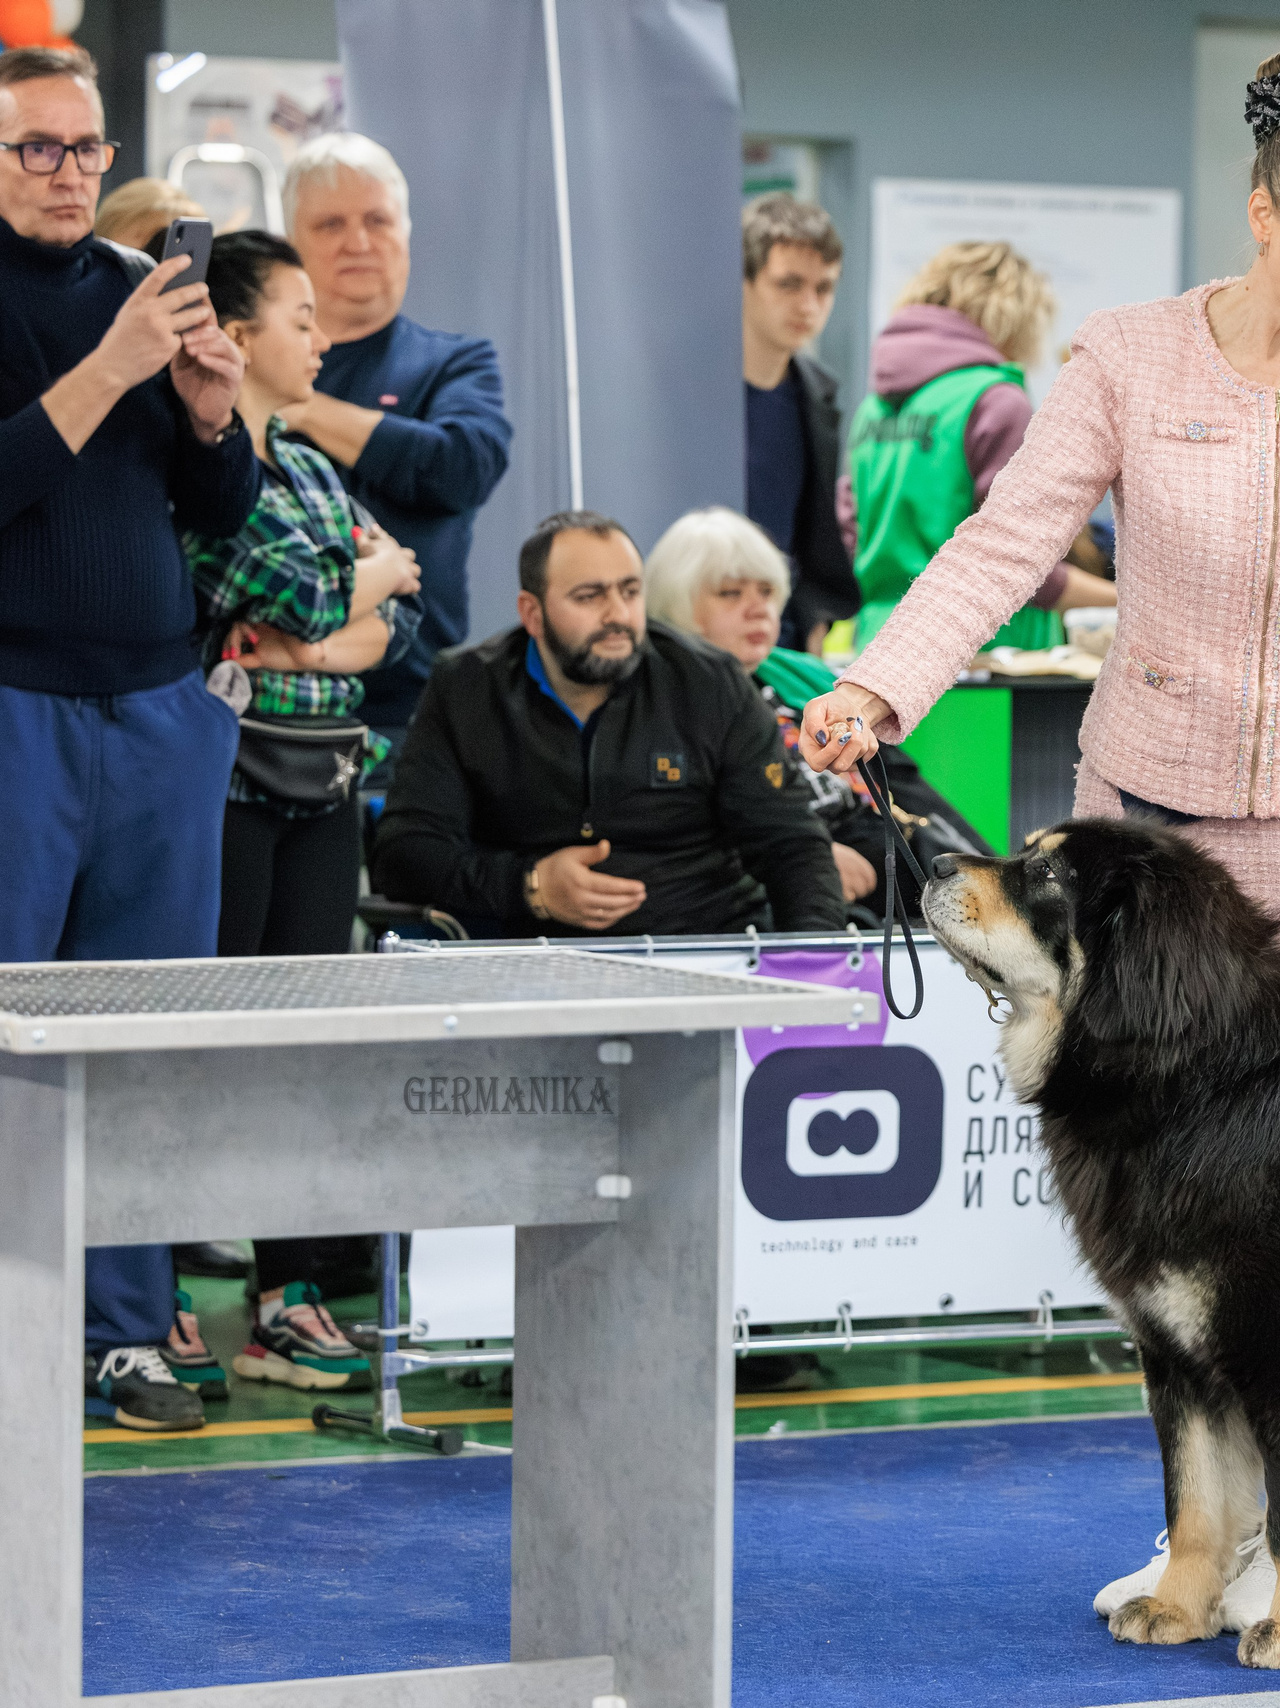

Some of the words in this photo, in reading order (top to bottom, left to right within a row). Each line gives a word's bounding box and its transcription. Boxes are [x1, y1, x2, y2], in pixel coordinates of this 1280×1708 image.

[403, 1076, 615, 1116] GERMANIKA
[963, 1115, 1032, 1163] ДЛЯ
[964, 1168, 983, 1208] И
[761, 1237, 843, 1253] technology
[853, 1234, 877, 1249] and
[885, 1235, 918, 1247] care
